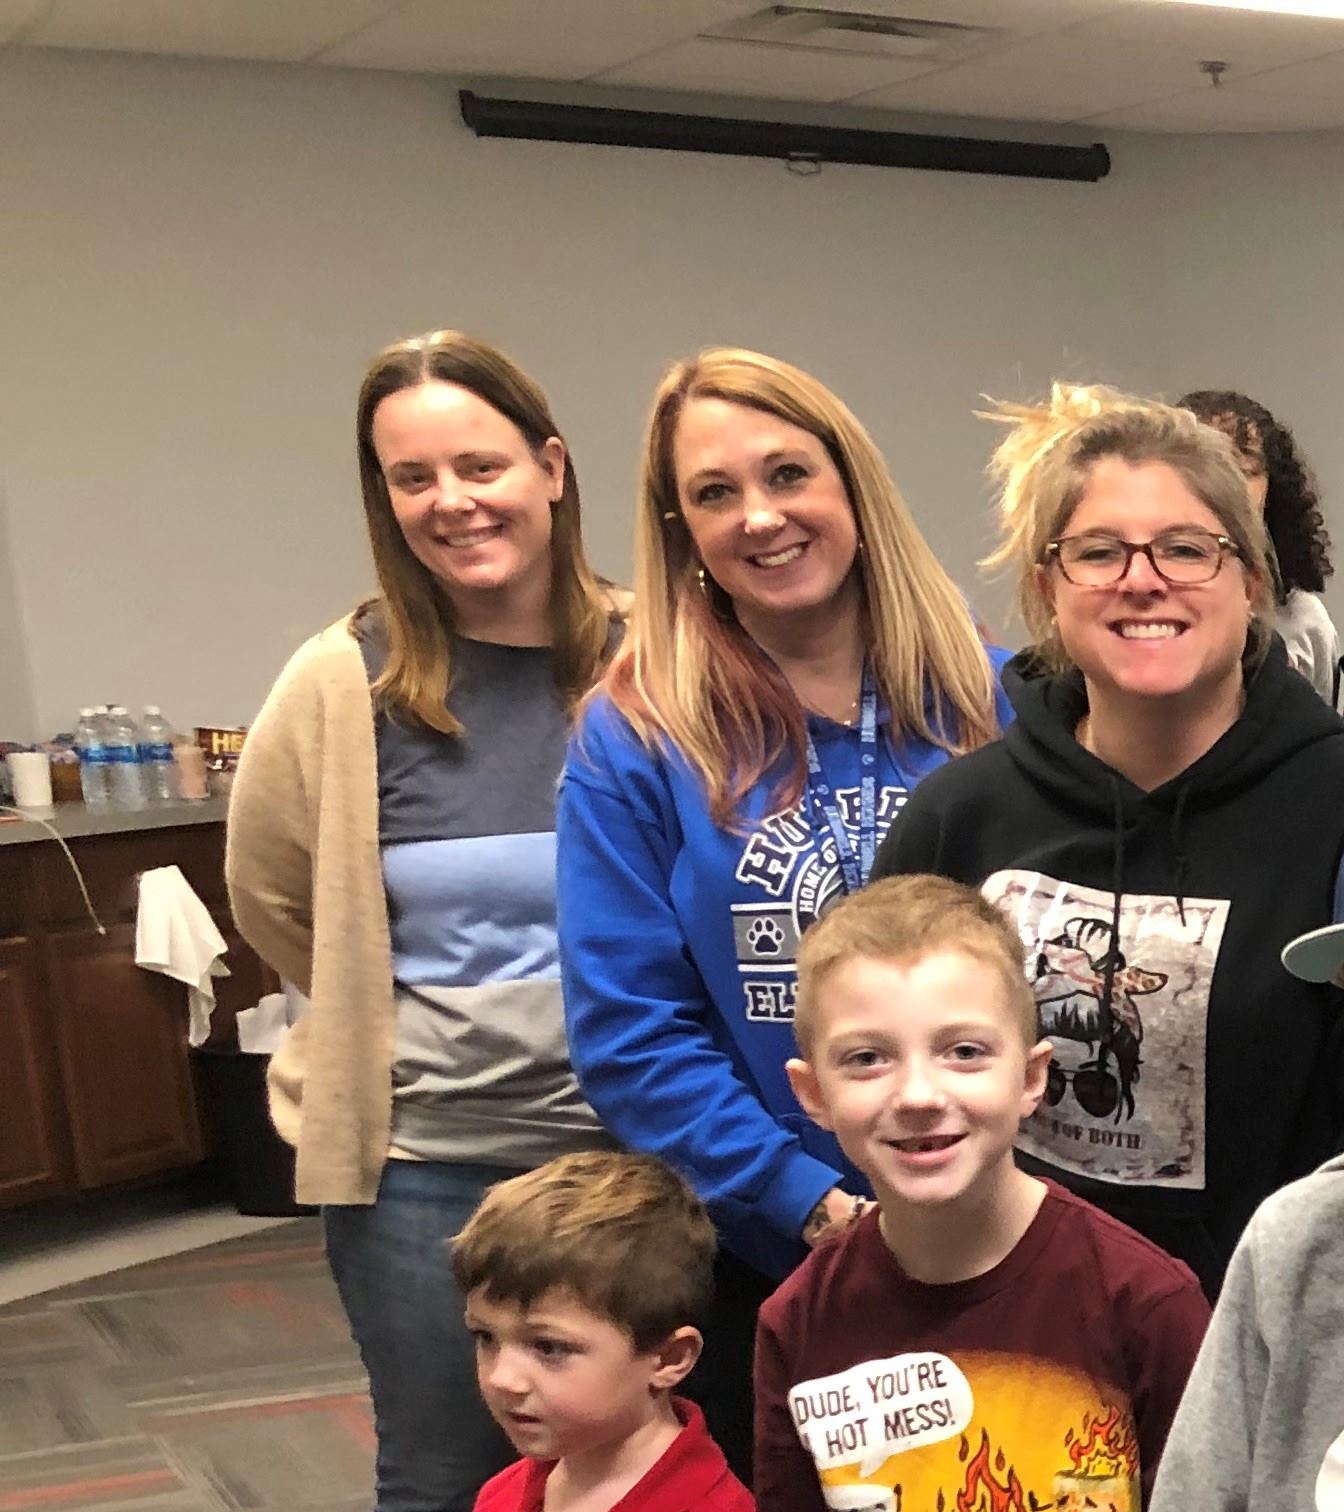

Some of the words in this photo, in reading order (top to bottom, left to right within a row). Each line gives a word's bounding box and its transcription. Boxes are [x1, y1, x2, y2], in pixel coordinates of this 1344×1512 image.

[799, 862, 828, 912] HOME
[1088, 1128, 1141, 1149] BOTH
[794, 1385, 861, 1426] DUDE,
[867, 1360, 947, 1404] YOU'RE
[826, 1418, 869, 1458] HOT
[884, 1399, 956, 1440] MESS!
